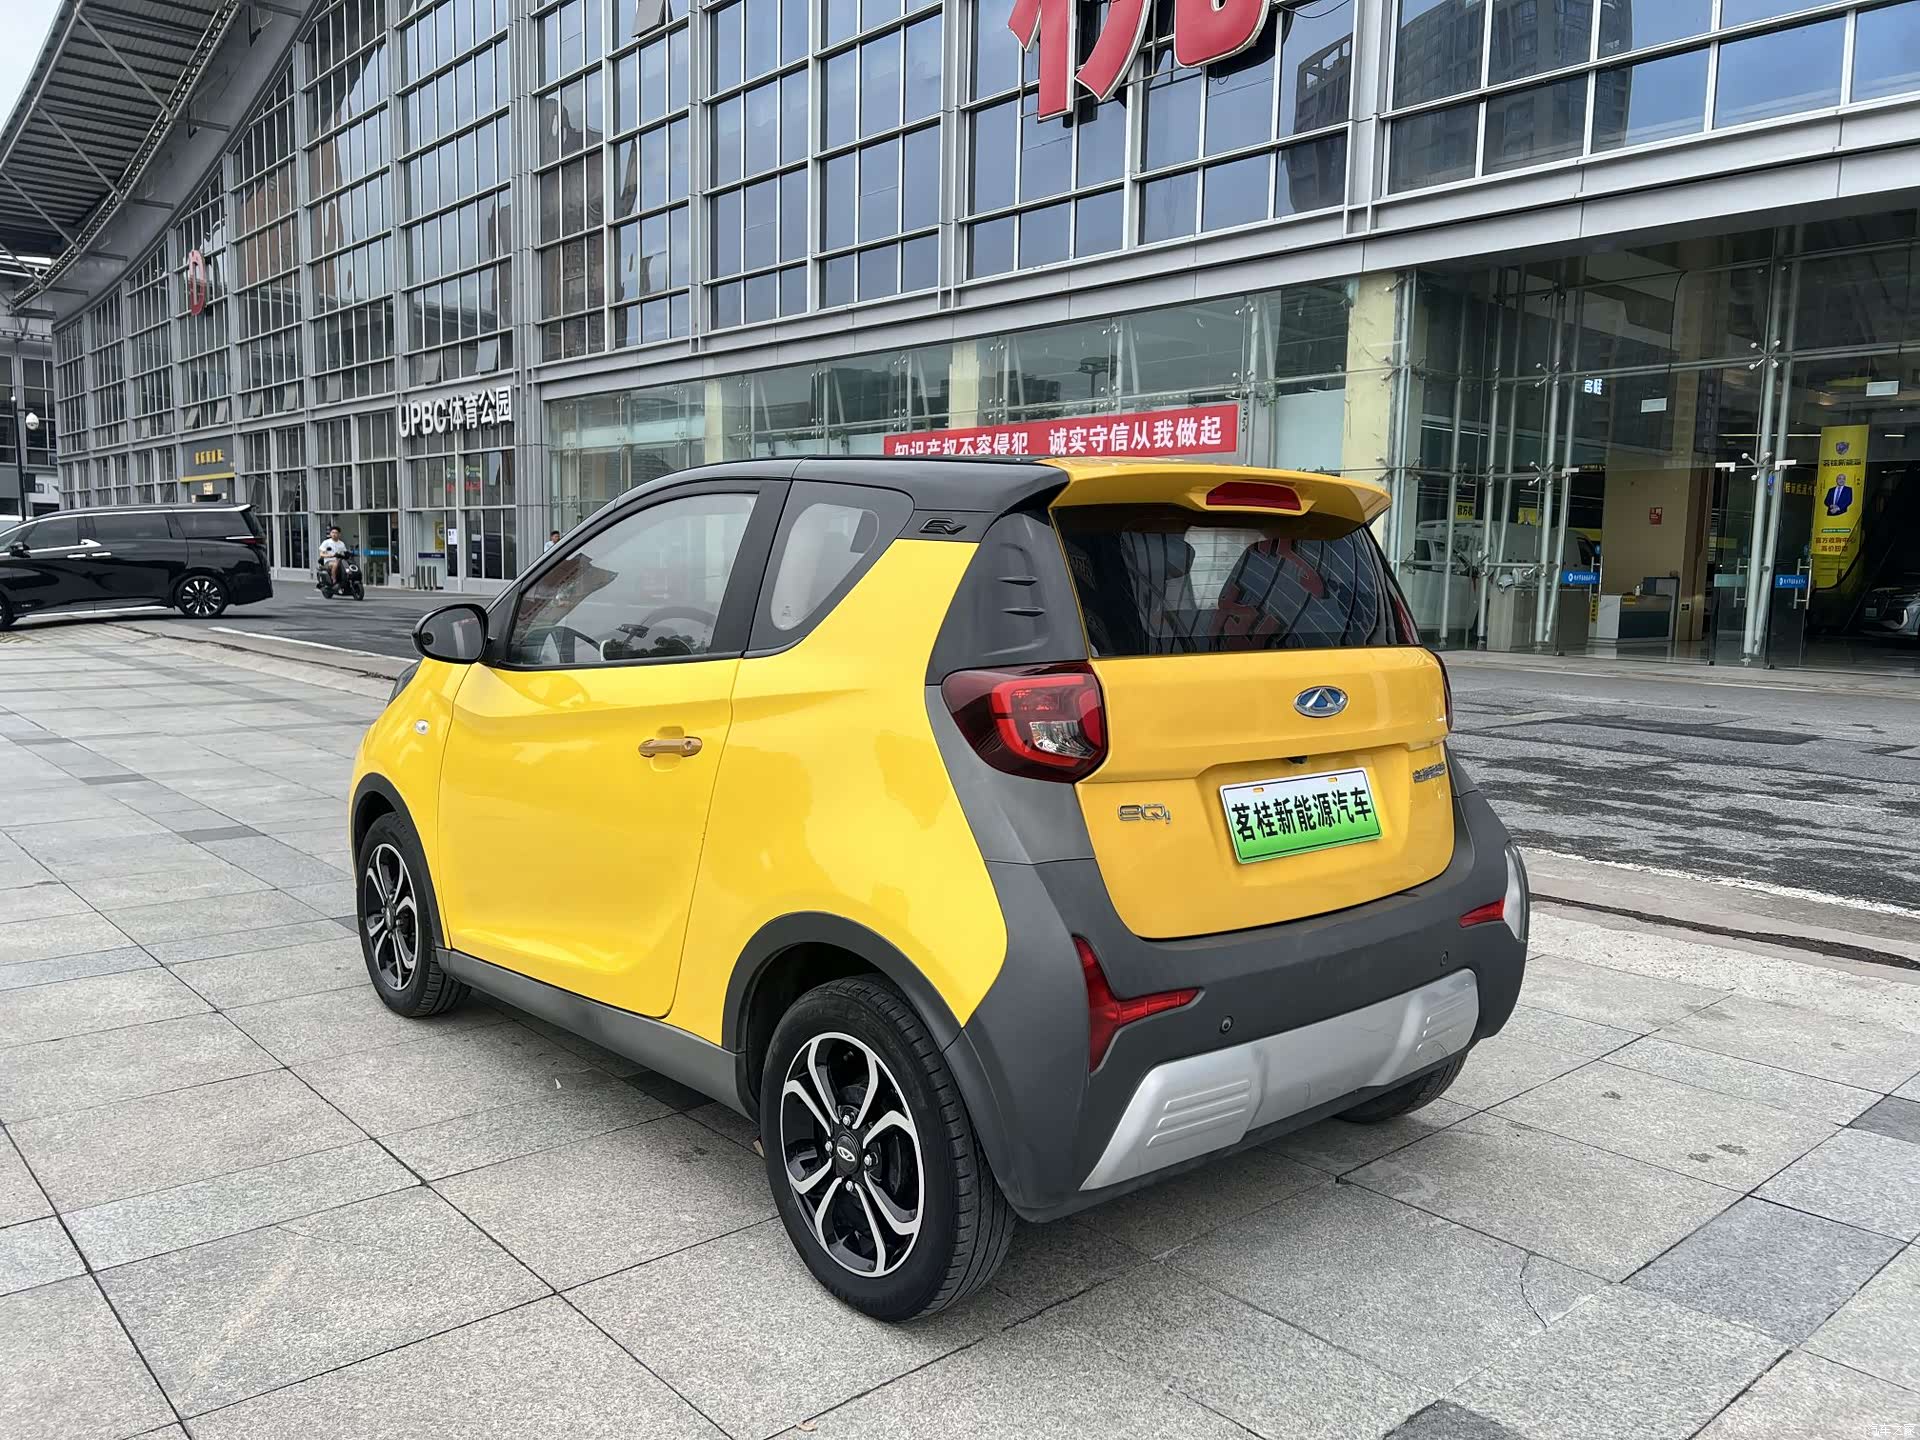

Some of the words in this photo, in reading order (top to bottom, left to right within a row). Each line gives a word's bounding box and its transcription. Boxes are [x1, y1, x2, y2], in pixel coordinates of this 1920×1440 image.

[399, 385, 511, 437] UPBC体育公园
[894, 431, 1029, 455] 知识产权不容侵犯
[1048, 416, 1221, 455] 诚实守信从我做起
[1231, 787, 1372, 842] 茗桂新能源汽车
